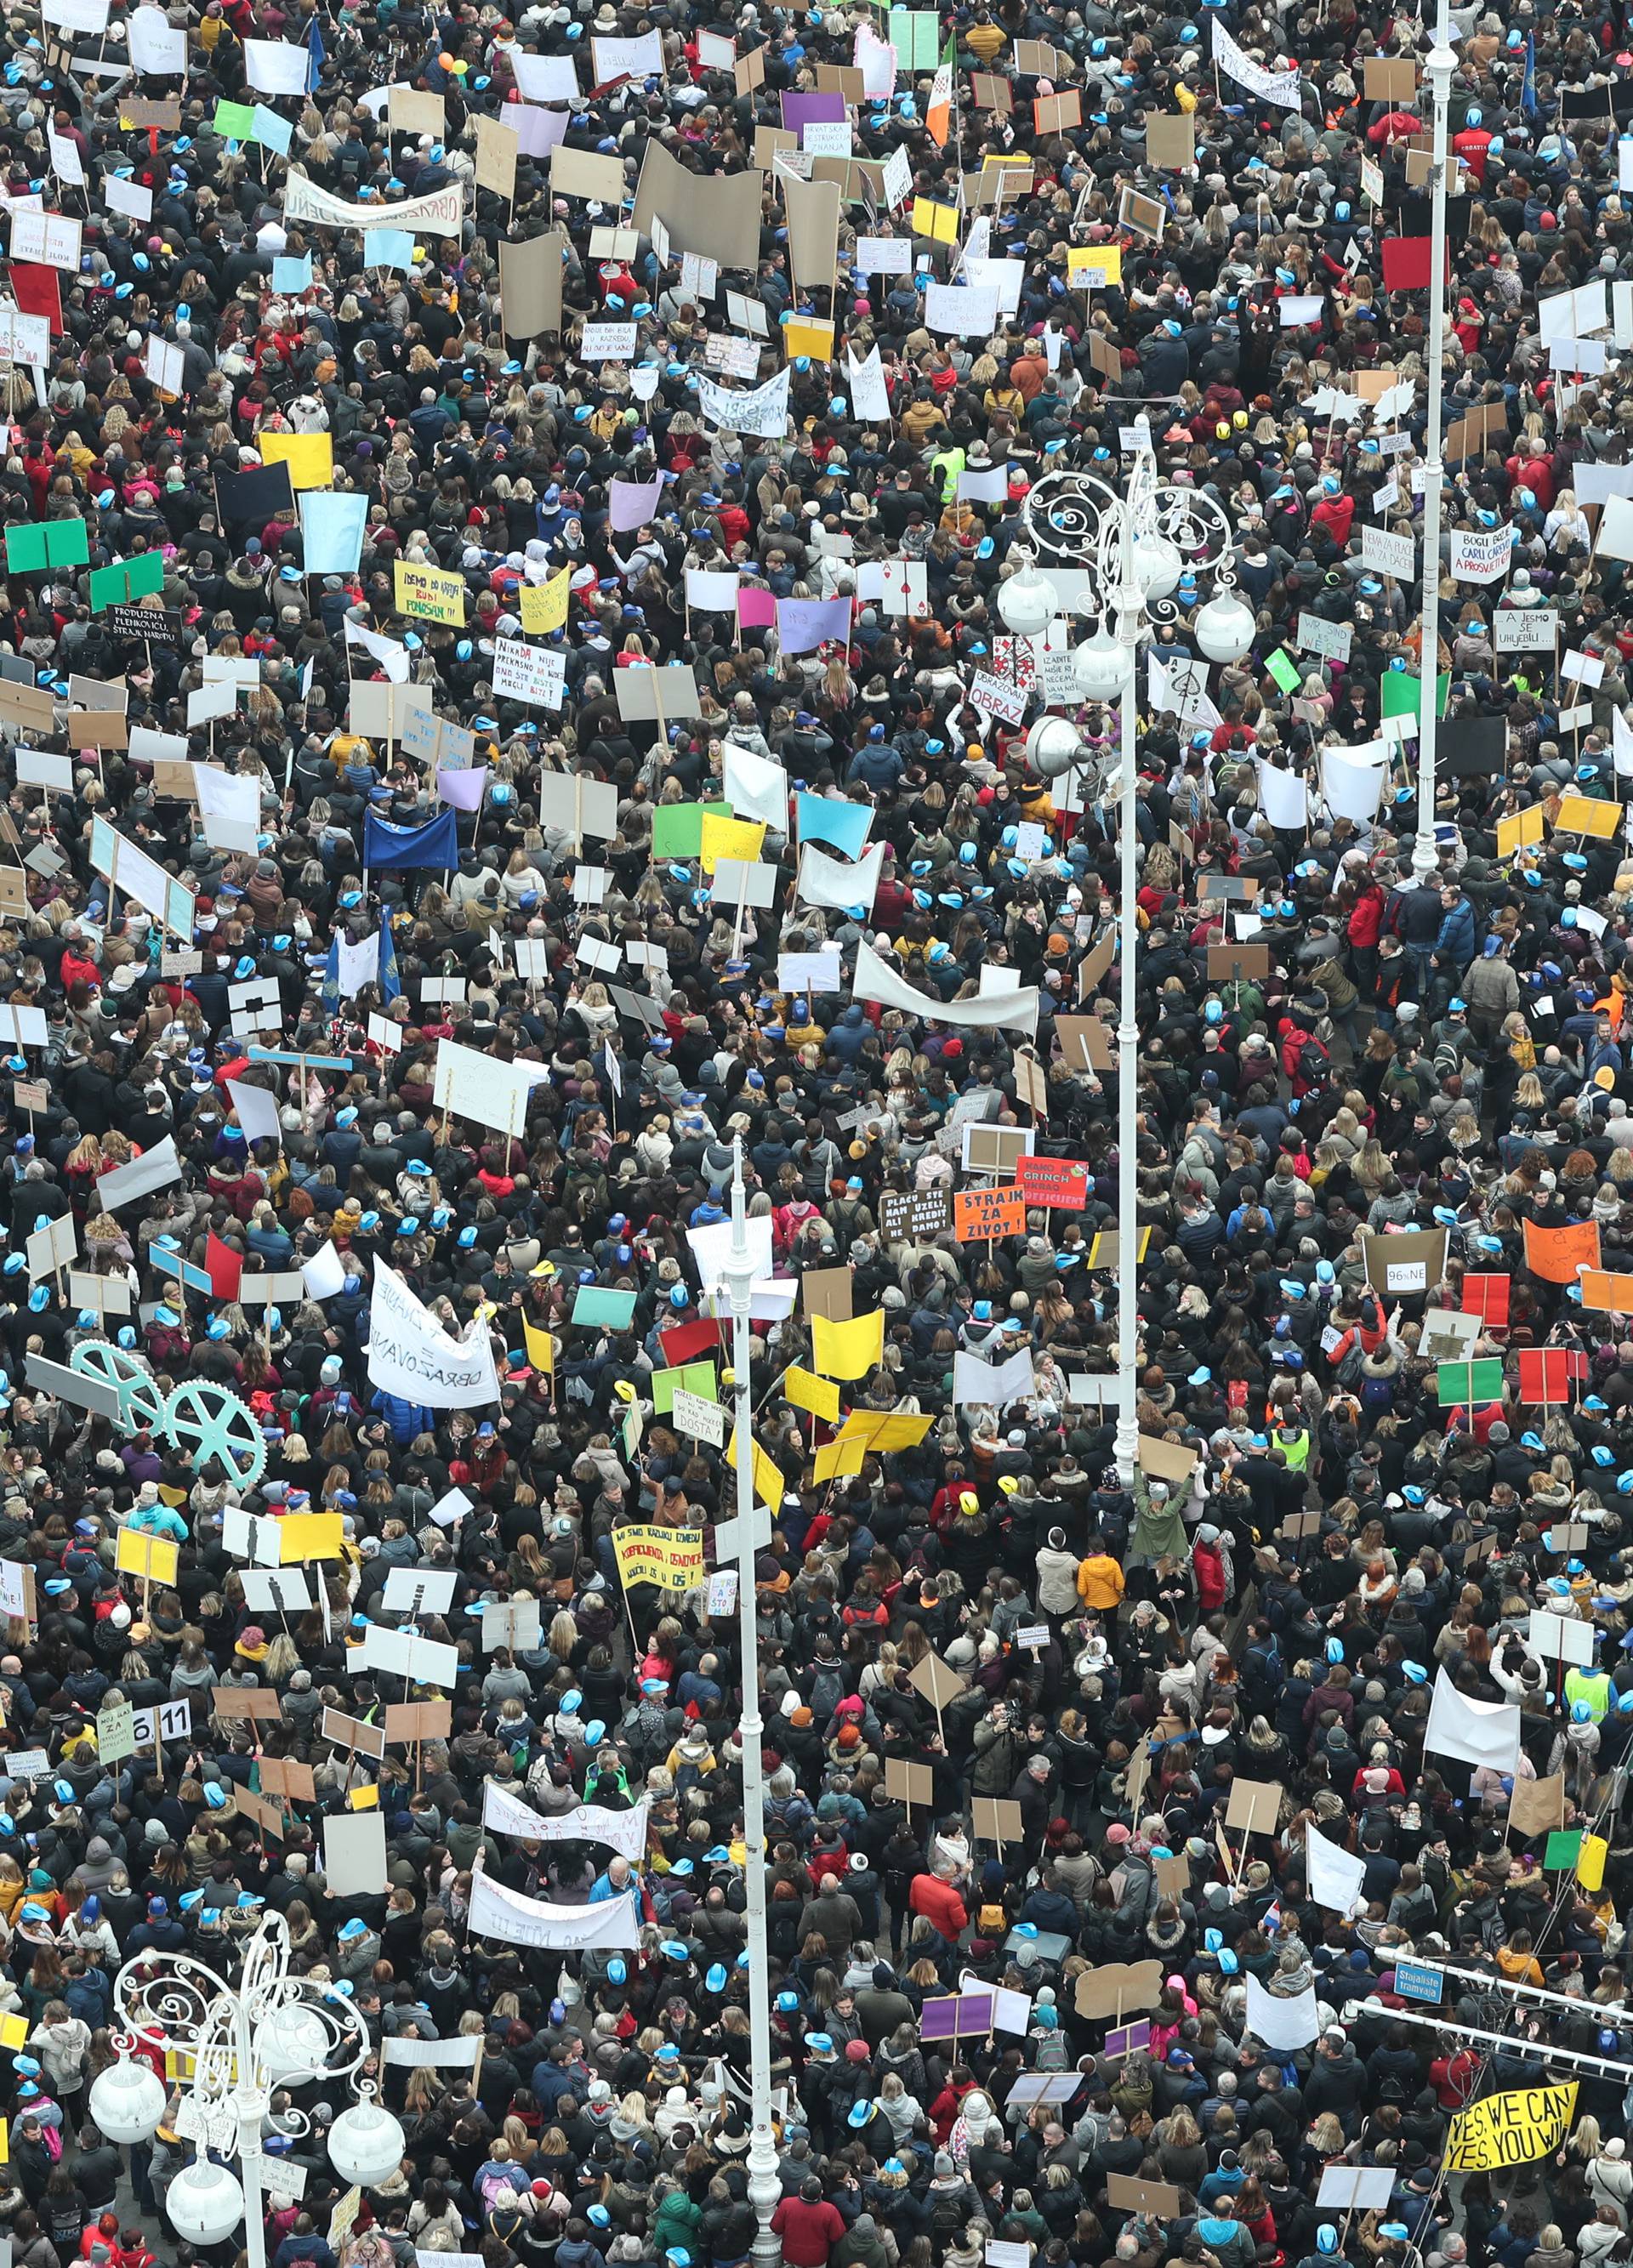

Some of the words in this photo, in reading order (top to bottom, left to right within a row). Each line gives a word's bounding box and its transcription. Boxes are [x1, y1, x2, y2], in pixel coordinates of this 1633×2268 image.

[806, 125, 845, 135] HRVATSKA
[814, 145, 845, 154] ZNANJA
[1463, 535, 1489, 547] BOGU
[1461, 547, 1486, 561] CARU
[1456, 558, 1464, 570] A
[1464, 559, 1501, 574] PROSVJETI
[404, 572, 427, 588] IDEMO
[416, 588, 437, 602] BUDI
[114, 606, 164, 621] PRODUŽNA
[407, 600, 445, 619] PONOSAN
[1506, 612, 1516, 622] A
[1521, 611, 1550, 622] JESMO
[112, 625, 143, 639] ŠTRAJK
[144, 632, 175, 642] NARODU
[1305, 618, 1321, 632] WIR
[1327, 624, 1347, 640] SIND
[1519, 622, 1533, 633] SE
[1303, 635, 1347, 659] WERT
[497, 654, 534, 672] PREKASNO
[538, 656, 555, 668] NIJE
[973, 688, 1024, 725] OBRAZ
[1023, 1171, 1070, 1183] GRINCH
[887, 1193, 919, 1208] PLAĆU
[926, 1190, 944, 1200] STE
[964, 1190, 1023, 1208] ŠTRAJK
[885, 1206, 908, 1218] NAM
[914, 1199, 947, 1213] UZELI,
[981, 1208, 1001, 1221] ZA
[885, 1216, 902, 1228] ALI
[911, 1209, 947, 1223] KREDIT
[890, 1229, 903, 1238] NE
[967, 1221, 1010, 1237] ŽIVOT
[680, 1414, 713, 1437] DOSTA
[661, 1572, 667, 1583] U
[672, 1571, 686, 1587] OŠ
[105, 1721, 122, 1734] ZA
[1400, 1981, 1437, 1998] tramvaja
[1453, 2106, 1488, 2142] YES,
[1486, 2094, 1522, 2129] WE
[1526, 2087, 1570, 2124] CAN
[1448, 2140, 1492, 2169] YES,
[1493, 2128, 1536, 2164] YOU
